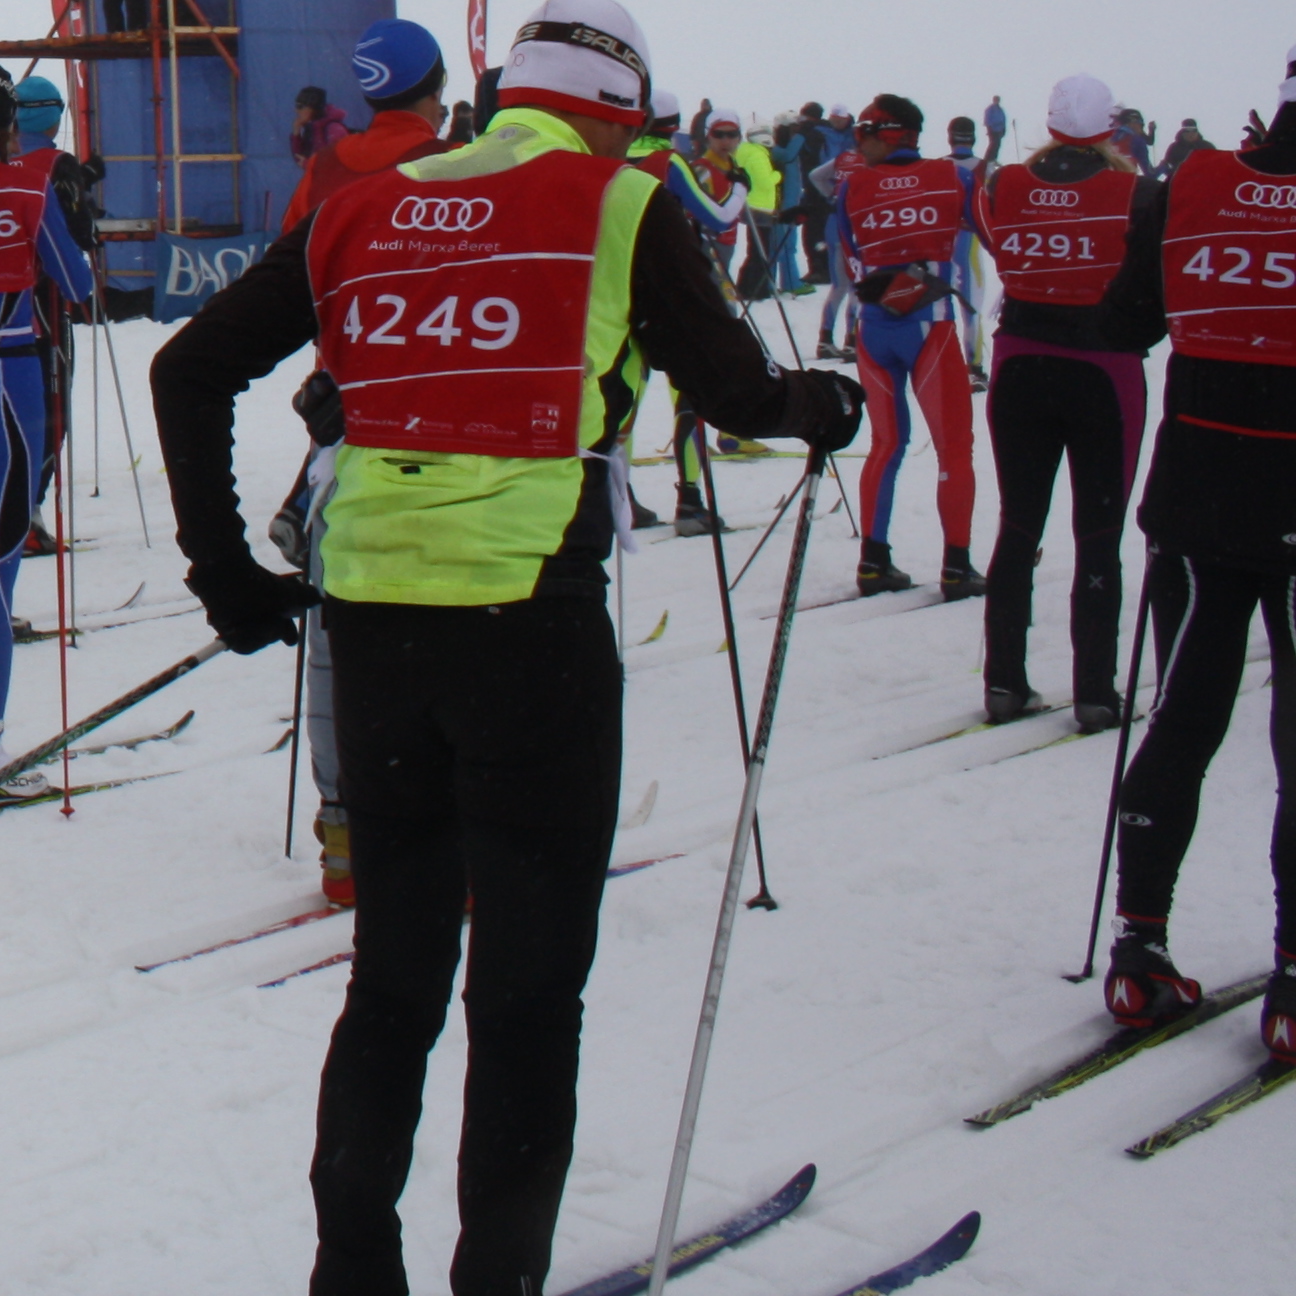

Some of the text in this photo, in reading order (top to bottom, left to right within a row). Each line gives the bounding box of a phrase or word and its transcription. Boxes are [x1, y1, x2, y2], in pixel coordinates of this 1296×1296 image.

[861, 206, 938, 229] 4290
[1217, 208, 1246, 219] Audi
[1249, 212, 1286, 223] Marxa
[368, 240, 500, 253] Audi Marxa Beret
[1001, 233, 1094, 259] 4291
[343, 294, 520, 350] 4249
